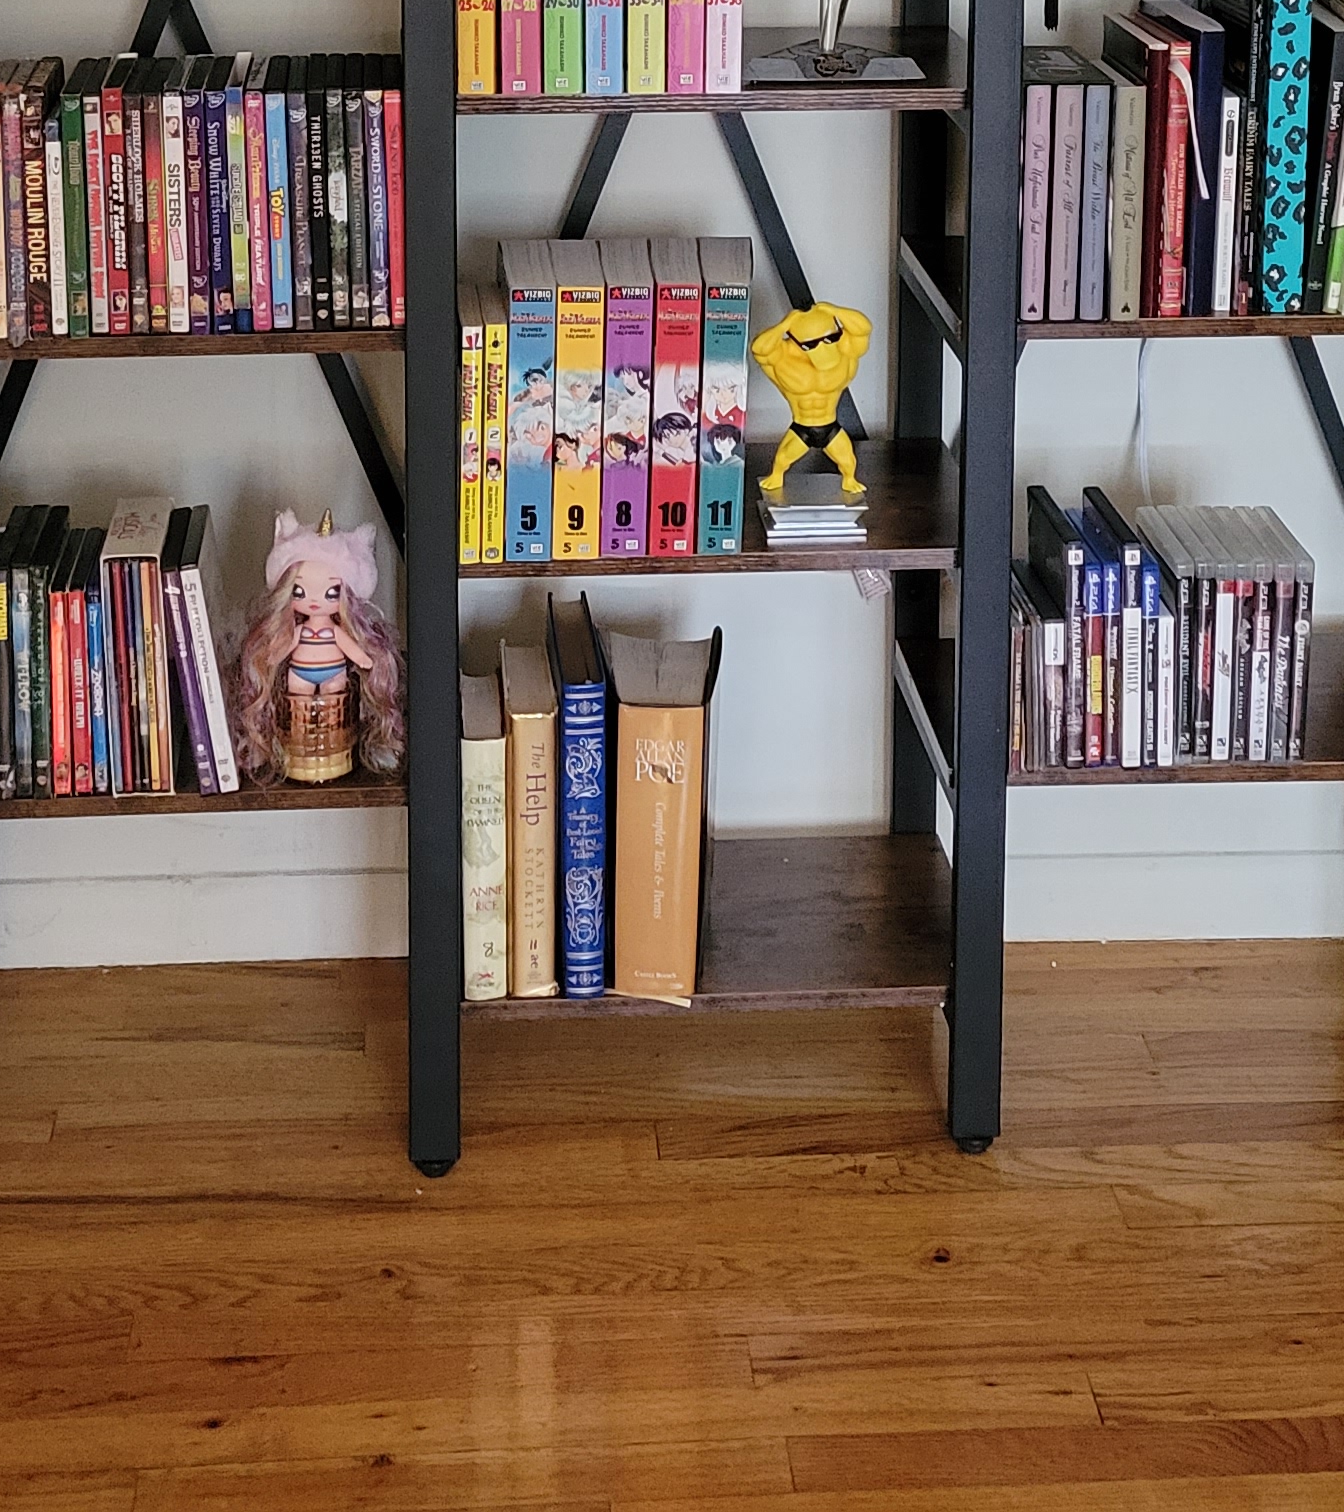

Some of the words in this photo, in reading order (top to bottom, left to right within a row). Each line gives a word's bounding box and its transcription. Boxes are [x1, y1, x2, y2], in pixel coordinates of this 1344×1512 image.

[131, 110, 141, 171] SHERLOCK
[310, 115, 322, 169] THIR13EN
[370, 128, 382, 173] SWORD
[25, 160, 44, 224] MOULIN
[111, 154, 125, 201] SCOTT
[133, 174, 144, 223] HOLMES
[167, 163, 181, 228] SISTERS
[312, 175, 323, 218] GHOSTS
[270, 188, 285, 217] TOY
[372, 184, 384, 231] STONE
[28, 228, 47, 283] ROUGE
[112, 206, 126, 269] PILGRIM
[521, 505, 537, 531] 5
[568, 505, 584, 530] 9
[616, 501, 631, 526] 8
[658, 502, 687, 527] 10
[707, 501, 732, 526] 11
[1126, 627, 1139, 649] FINAL
[1126, 652, 1139, 686] FANTASY
[530, 743, 545, 769] The
[519, 772, 547, 826] Help
[652, 802, 666, 847] Complete
[653, 849, 666, 874] Tales
[470, 886, 503, 897] ANNE
[475, 902, 499, 911] RICE
[523, 848, 535, 930] STOCKETT
[535, 848, 545, 930] KATHRYN
[652, 889, 664, 920] Poems
